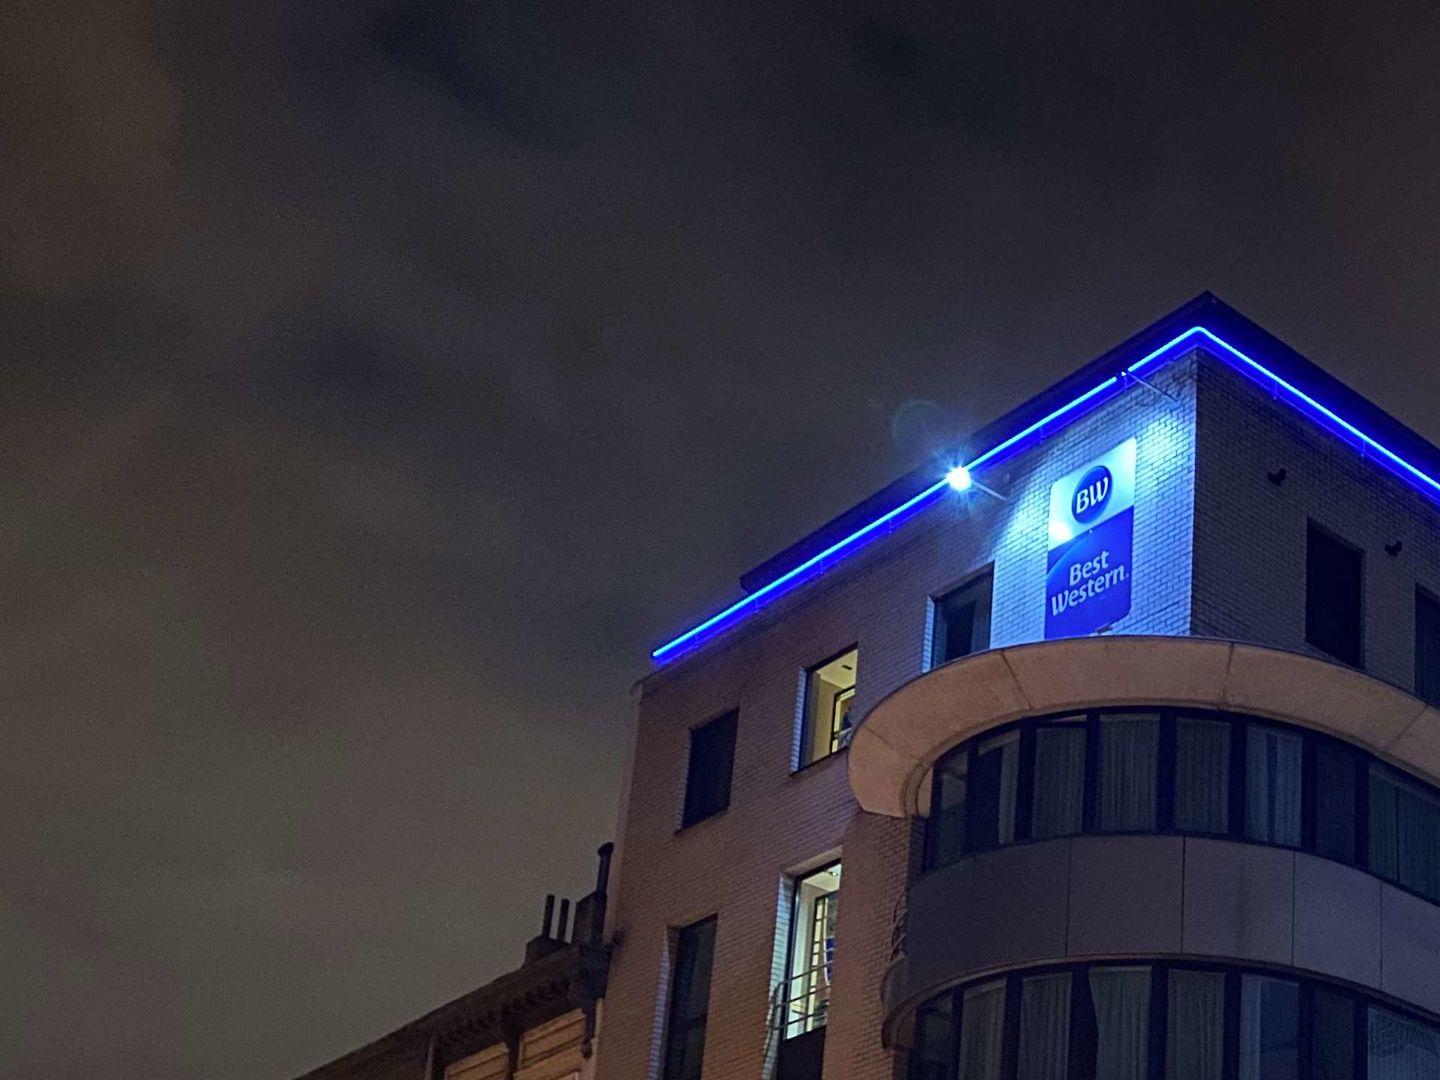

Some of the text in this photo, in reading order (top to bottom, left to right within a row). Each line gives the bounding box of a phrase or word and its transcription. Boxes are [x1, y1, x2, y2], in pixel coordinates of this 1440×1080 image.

[1075, 476, 1109, 514] BW
[1068, 549, 1109, 587] Best
[1050, 564, 1127, 617] Western
